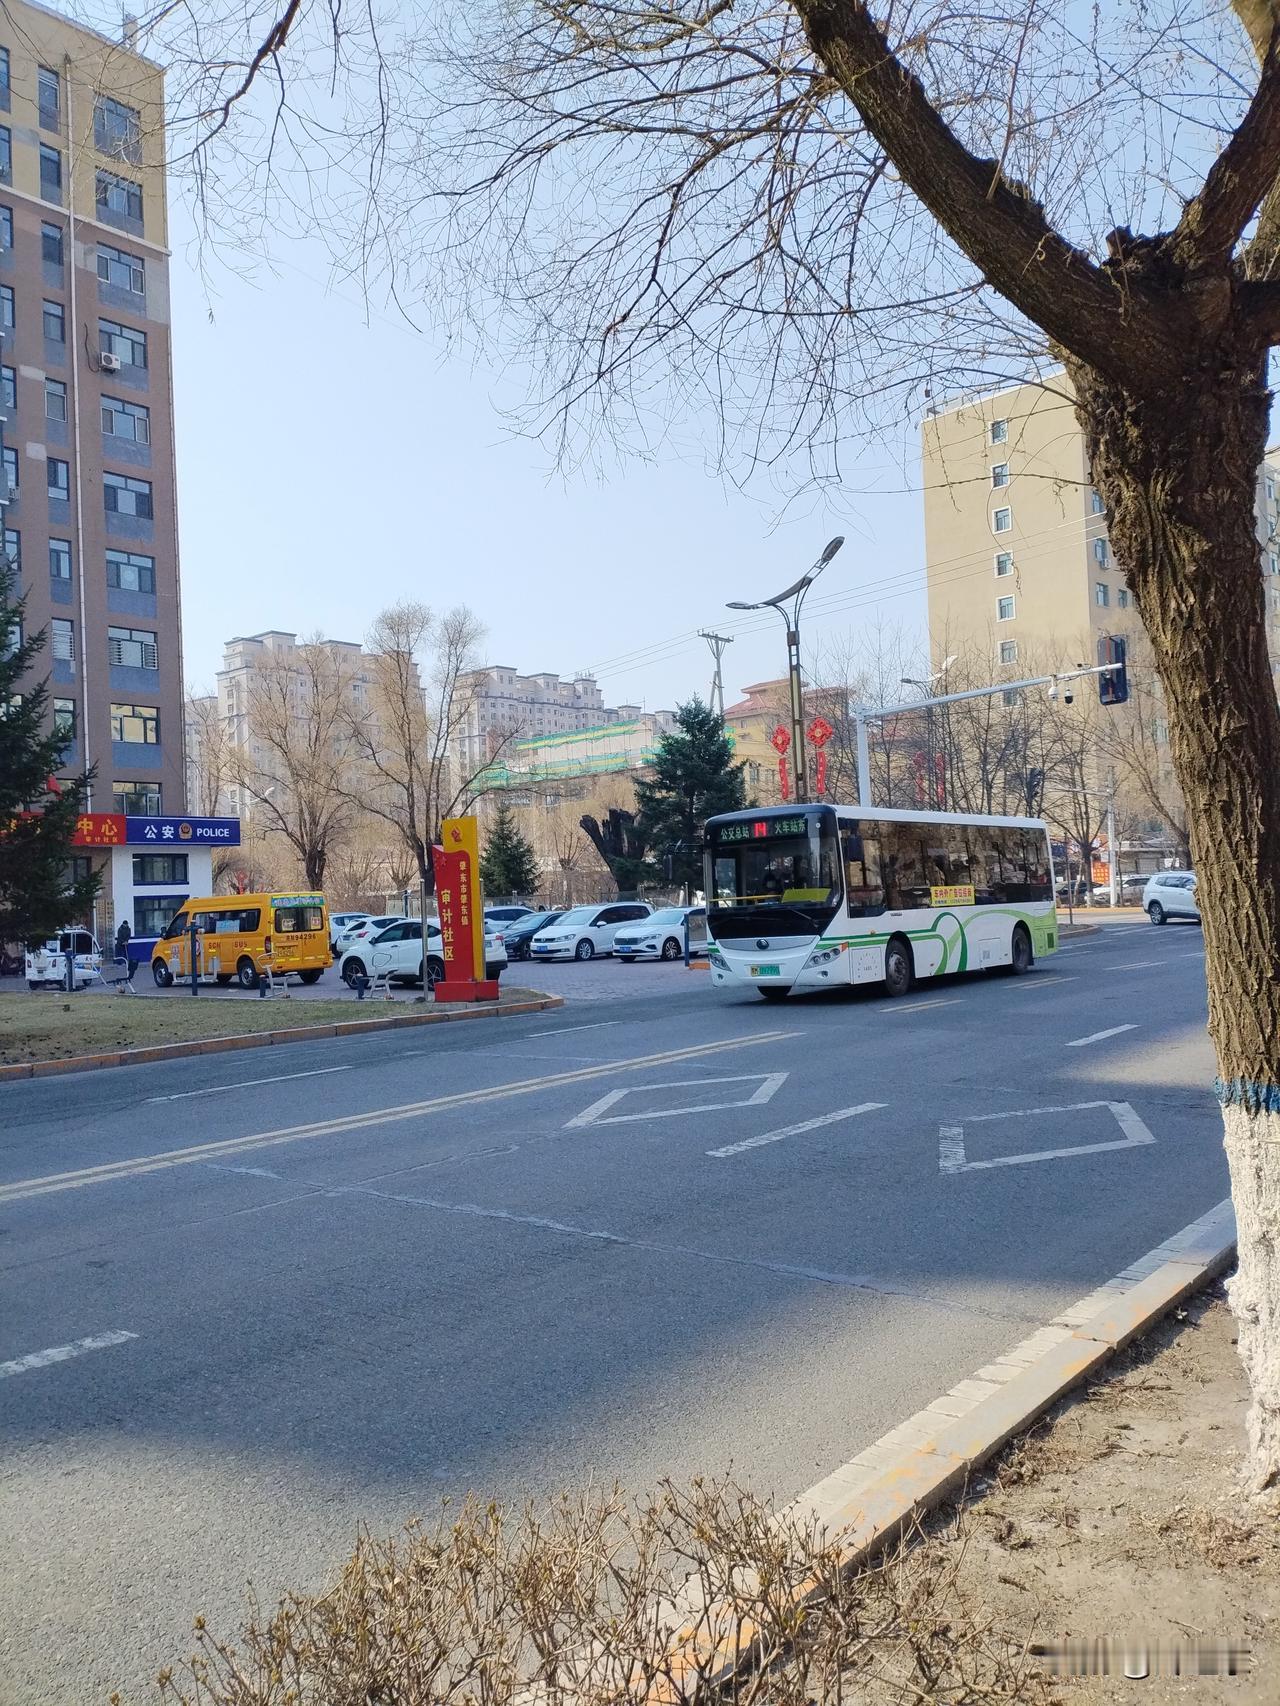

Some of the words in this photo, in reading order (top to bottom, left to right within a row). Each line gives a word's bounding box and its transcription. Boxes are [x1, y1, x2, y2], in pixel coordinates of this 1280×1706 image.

[144, 825, 175, 839] 公安
[196, 827, 230, 838] POLICE
[720, 826, 750, 840] 公交总站
[440, 888, 455, 961] 审计社区
